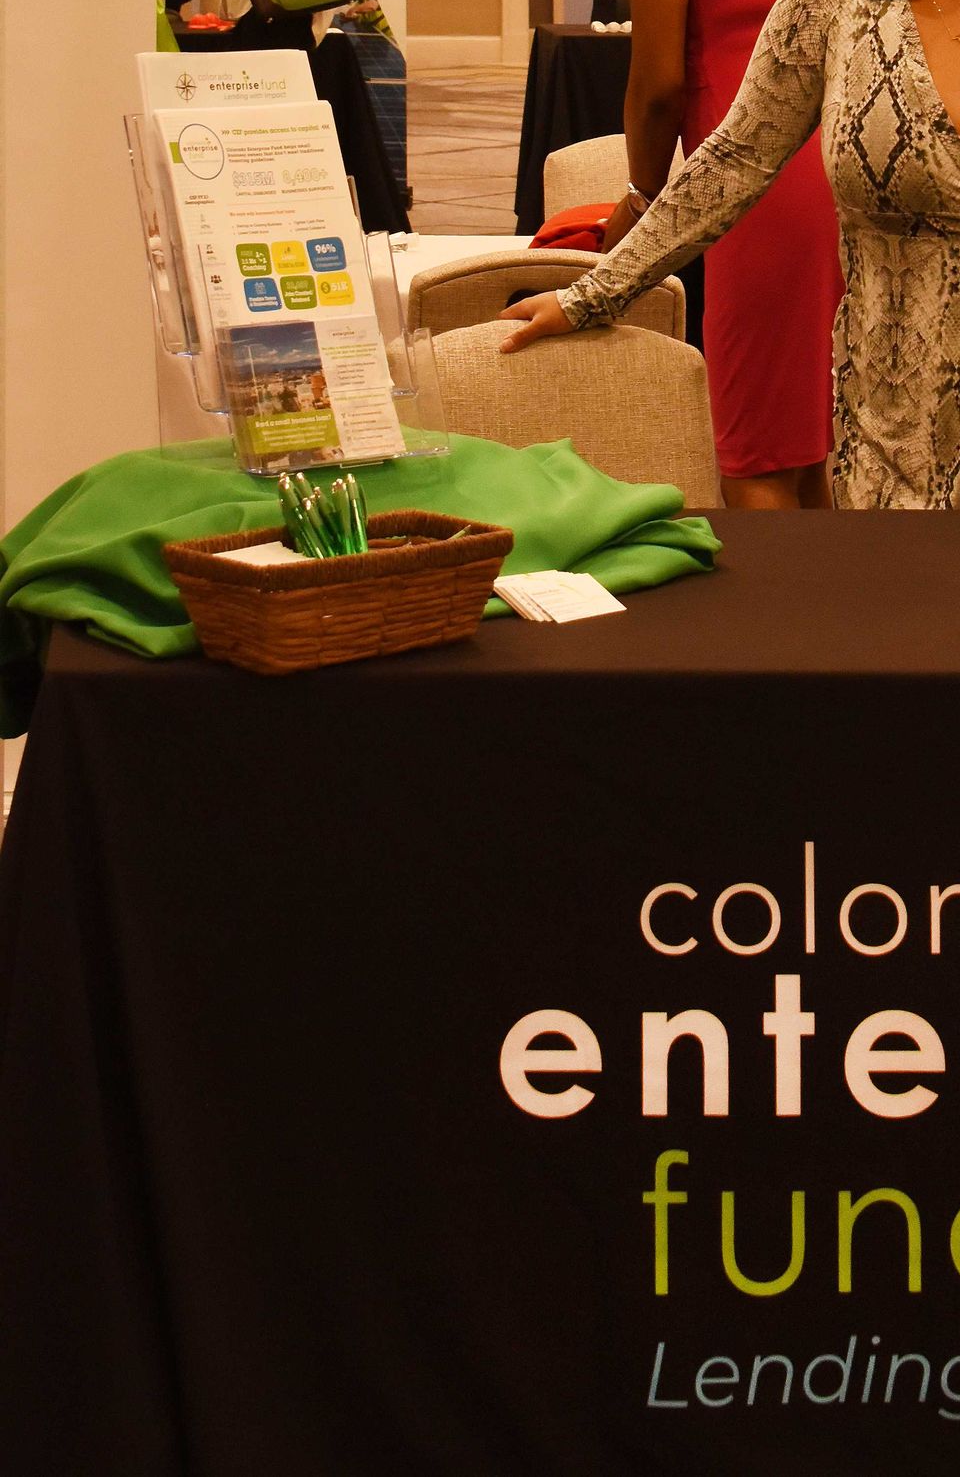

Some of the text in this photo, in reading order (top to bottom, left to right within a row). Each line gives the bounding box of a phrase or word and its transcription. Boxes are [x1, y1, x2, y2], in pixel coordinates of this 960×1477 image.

[209, 79, 286, 92] enterprise fund
[315, 244, 336, 254] 96%
